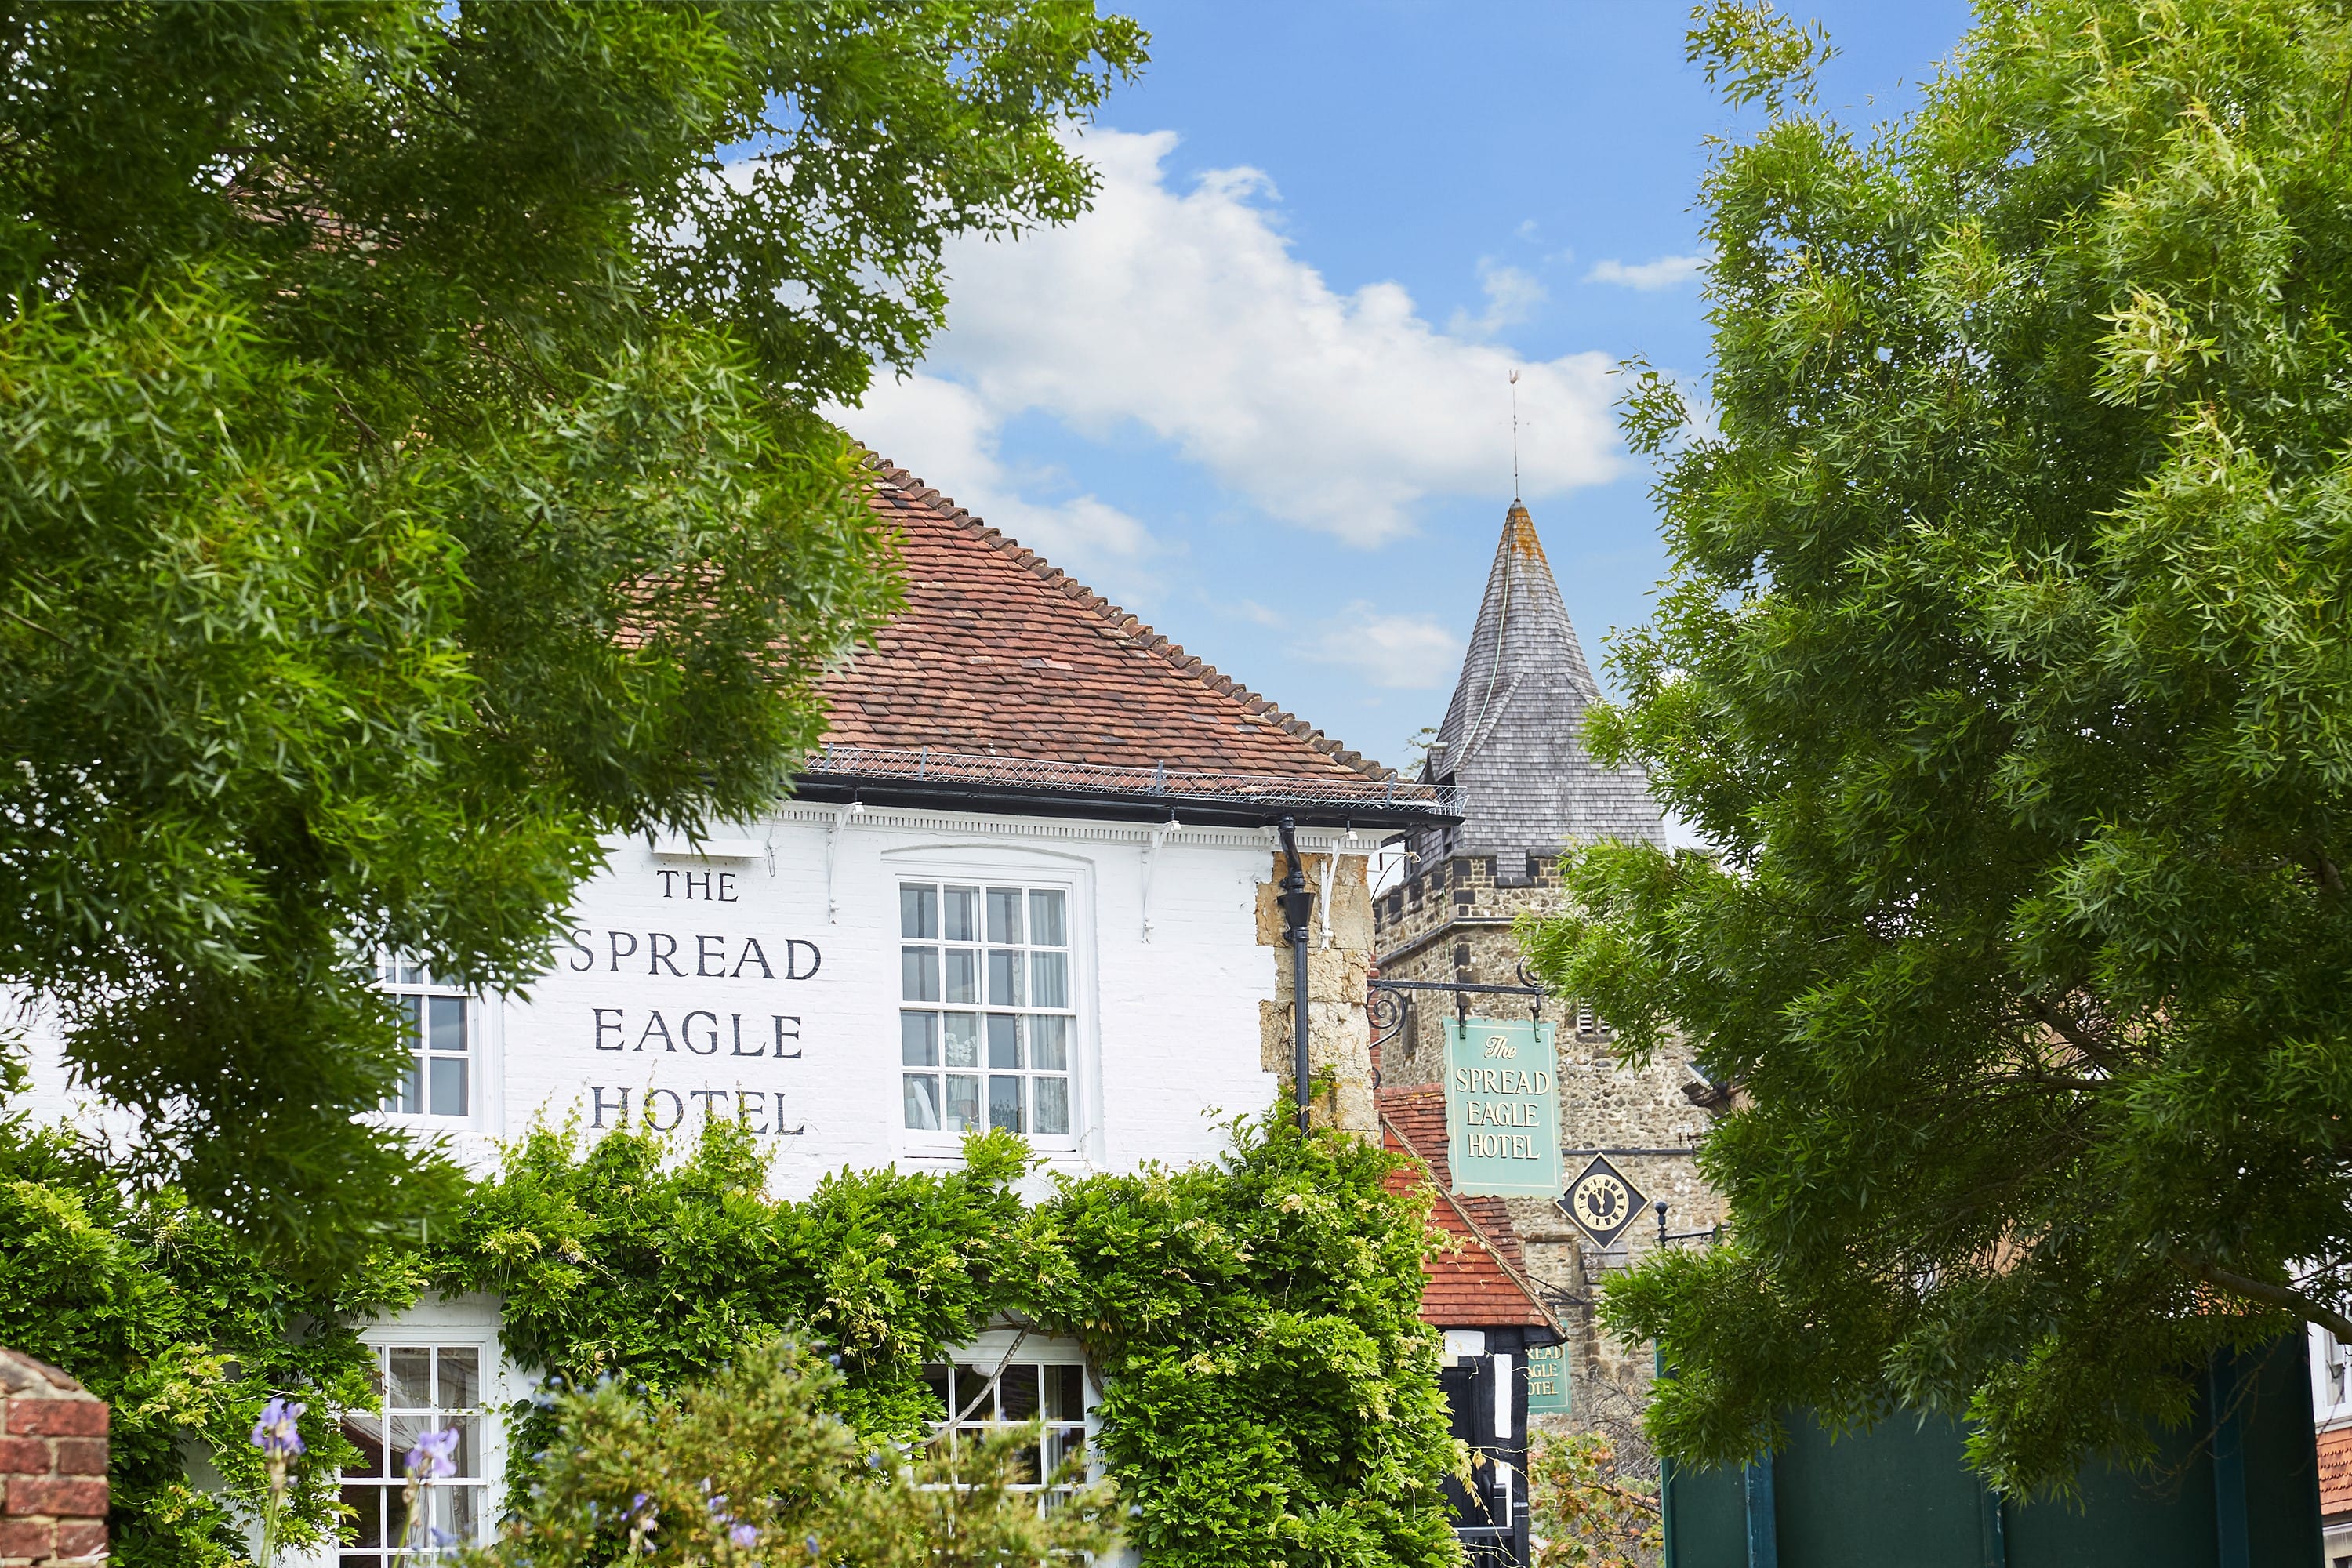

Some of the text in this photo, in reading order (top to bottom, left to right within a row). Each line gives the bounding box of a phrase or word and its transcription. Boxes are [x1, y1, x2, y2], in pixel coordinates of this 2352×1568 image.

[658, 870, 739, 902] THE
[570, 929, 822, 980] SPREAD
[592, 1008, 802, 1059] EAGLE
[1484, 1035, 1517, 1059] The
[1455, 1068, 1550, 1095] SPREAD
[590, 1087, 804, 1136] HOTEL
[1466, 1101, 1540, 1127] EAGLE
[1468, 1134, 1541, 1159] HOTEL
